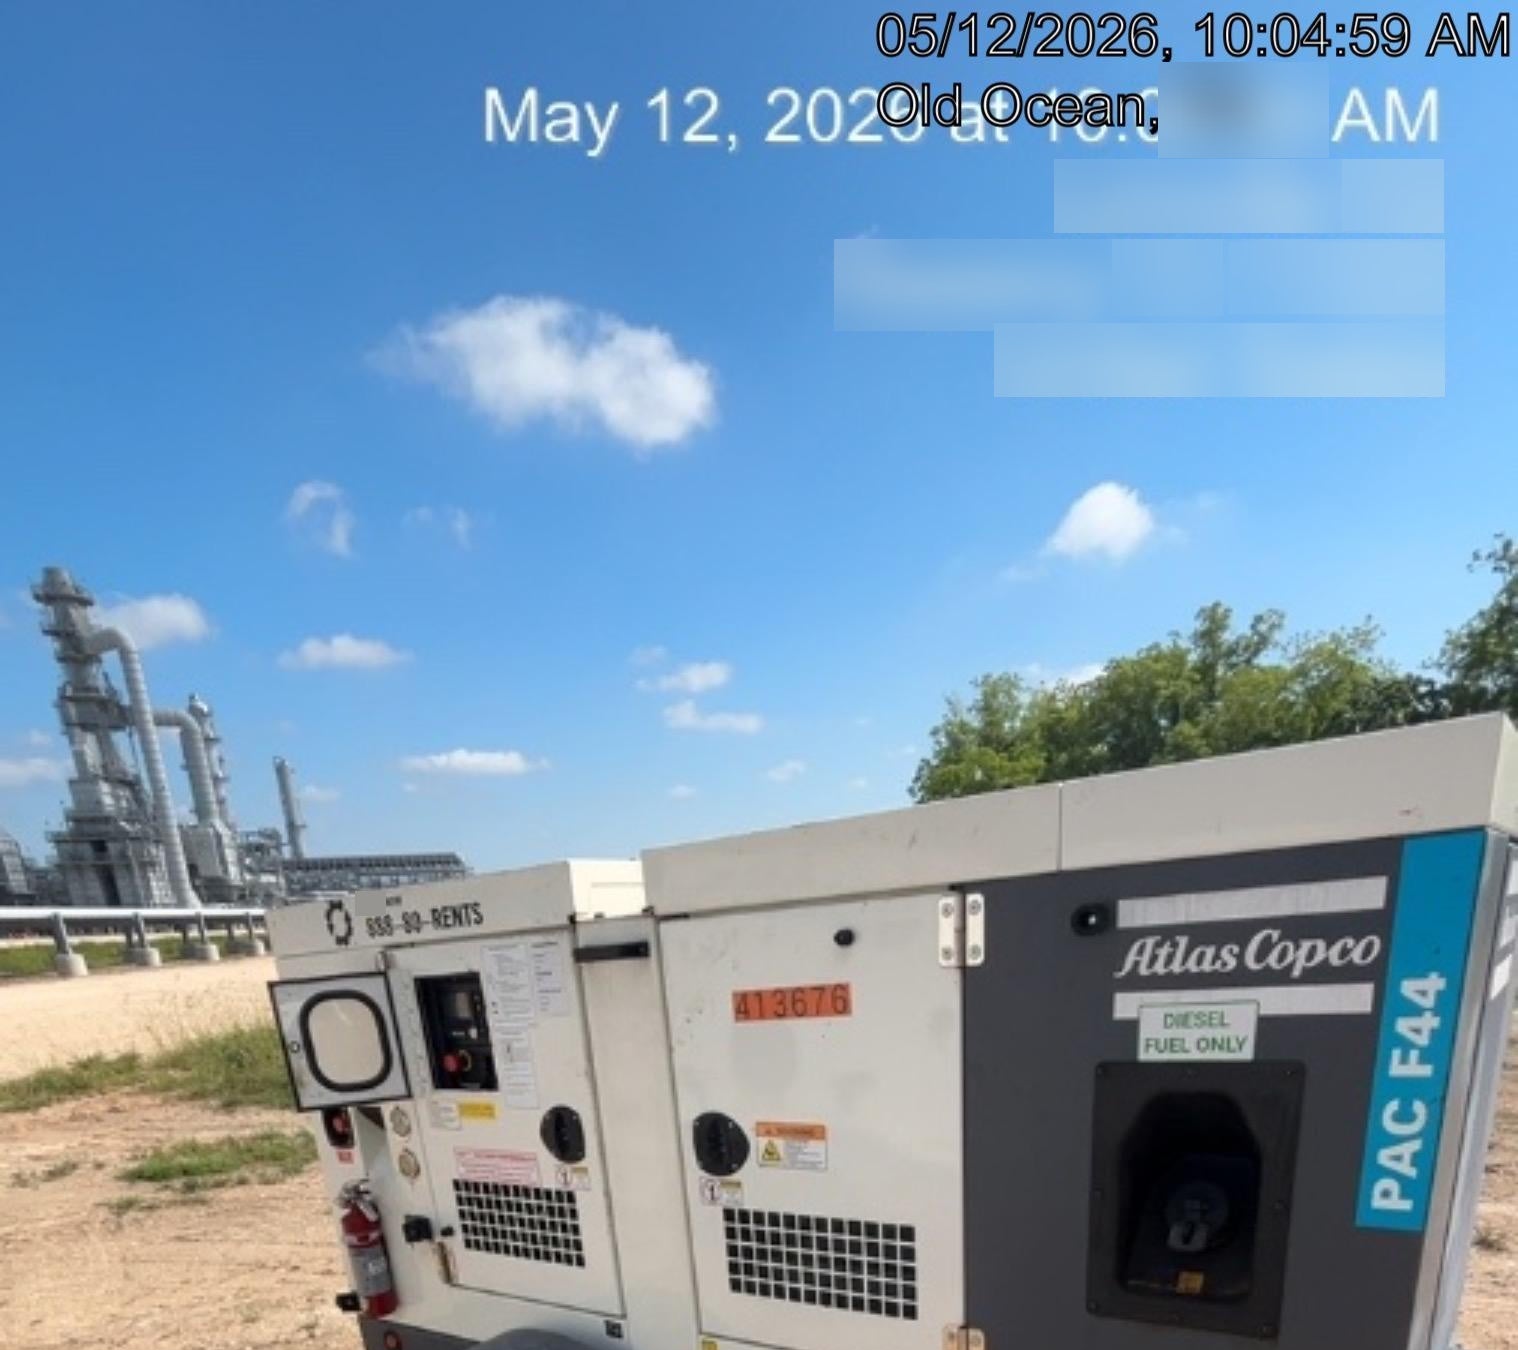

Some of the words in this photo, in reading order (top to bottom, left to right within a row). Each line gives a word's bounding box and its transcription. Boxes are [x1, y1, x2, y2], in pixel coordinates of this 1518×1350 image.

[1112, 934, 1240, 978] Atlas
[1244, 928, 1382, 978] Copco
[735, 983, 849, 1021] 413676
[1162, 1008, 1231, 1031] DIESEL
[1144, 1037, 1191, 1055] FUEL
[1196, 1035, 1249, 1055] ONLY
[1388, 970, 1448, 1079] F44
[1370, 1098, 1428, 1211] PAC
